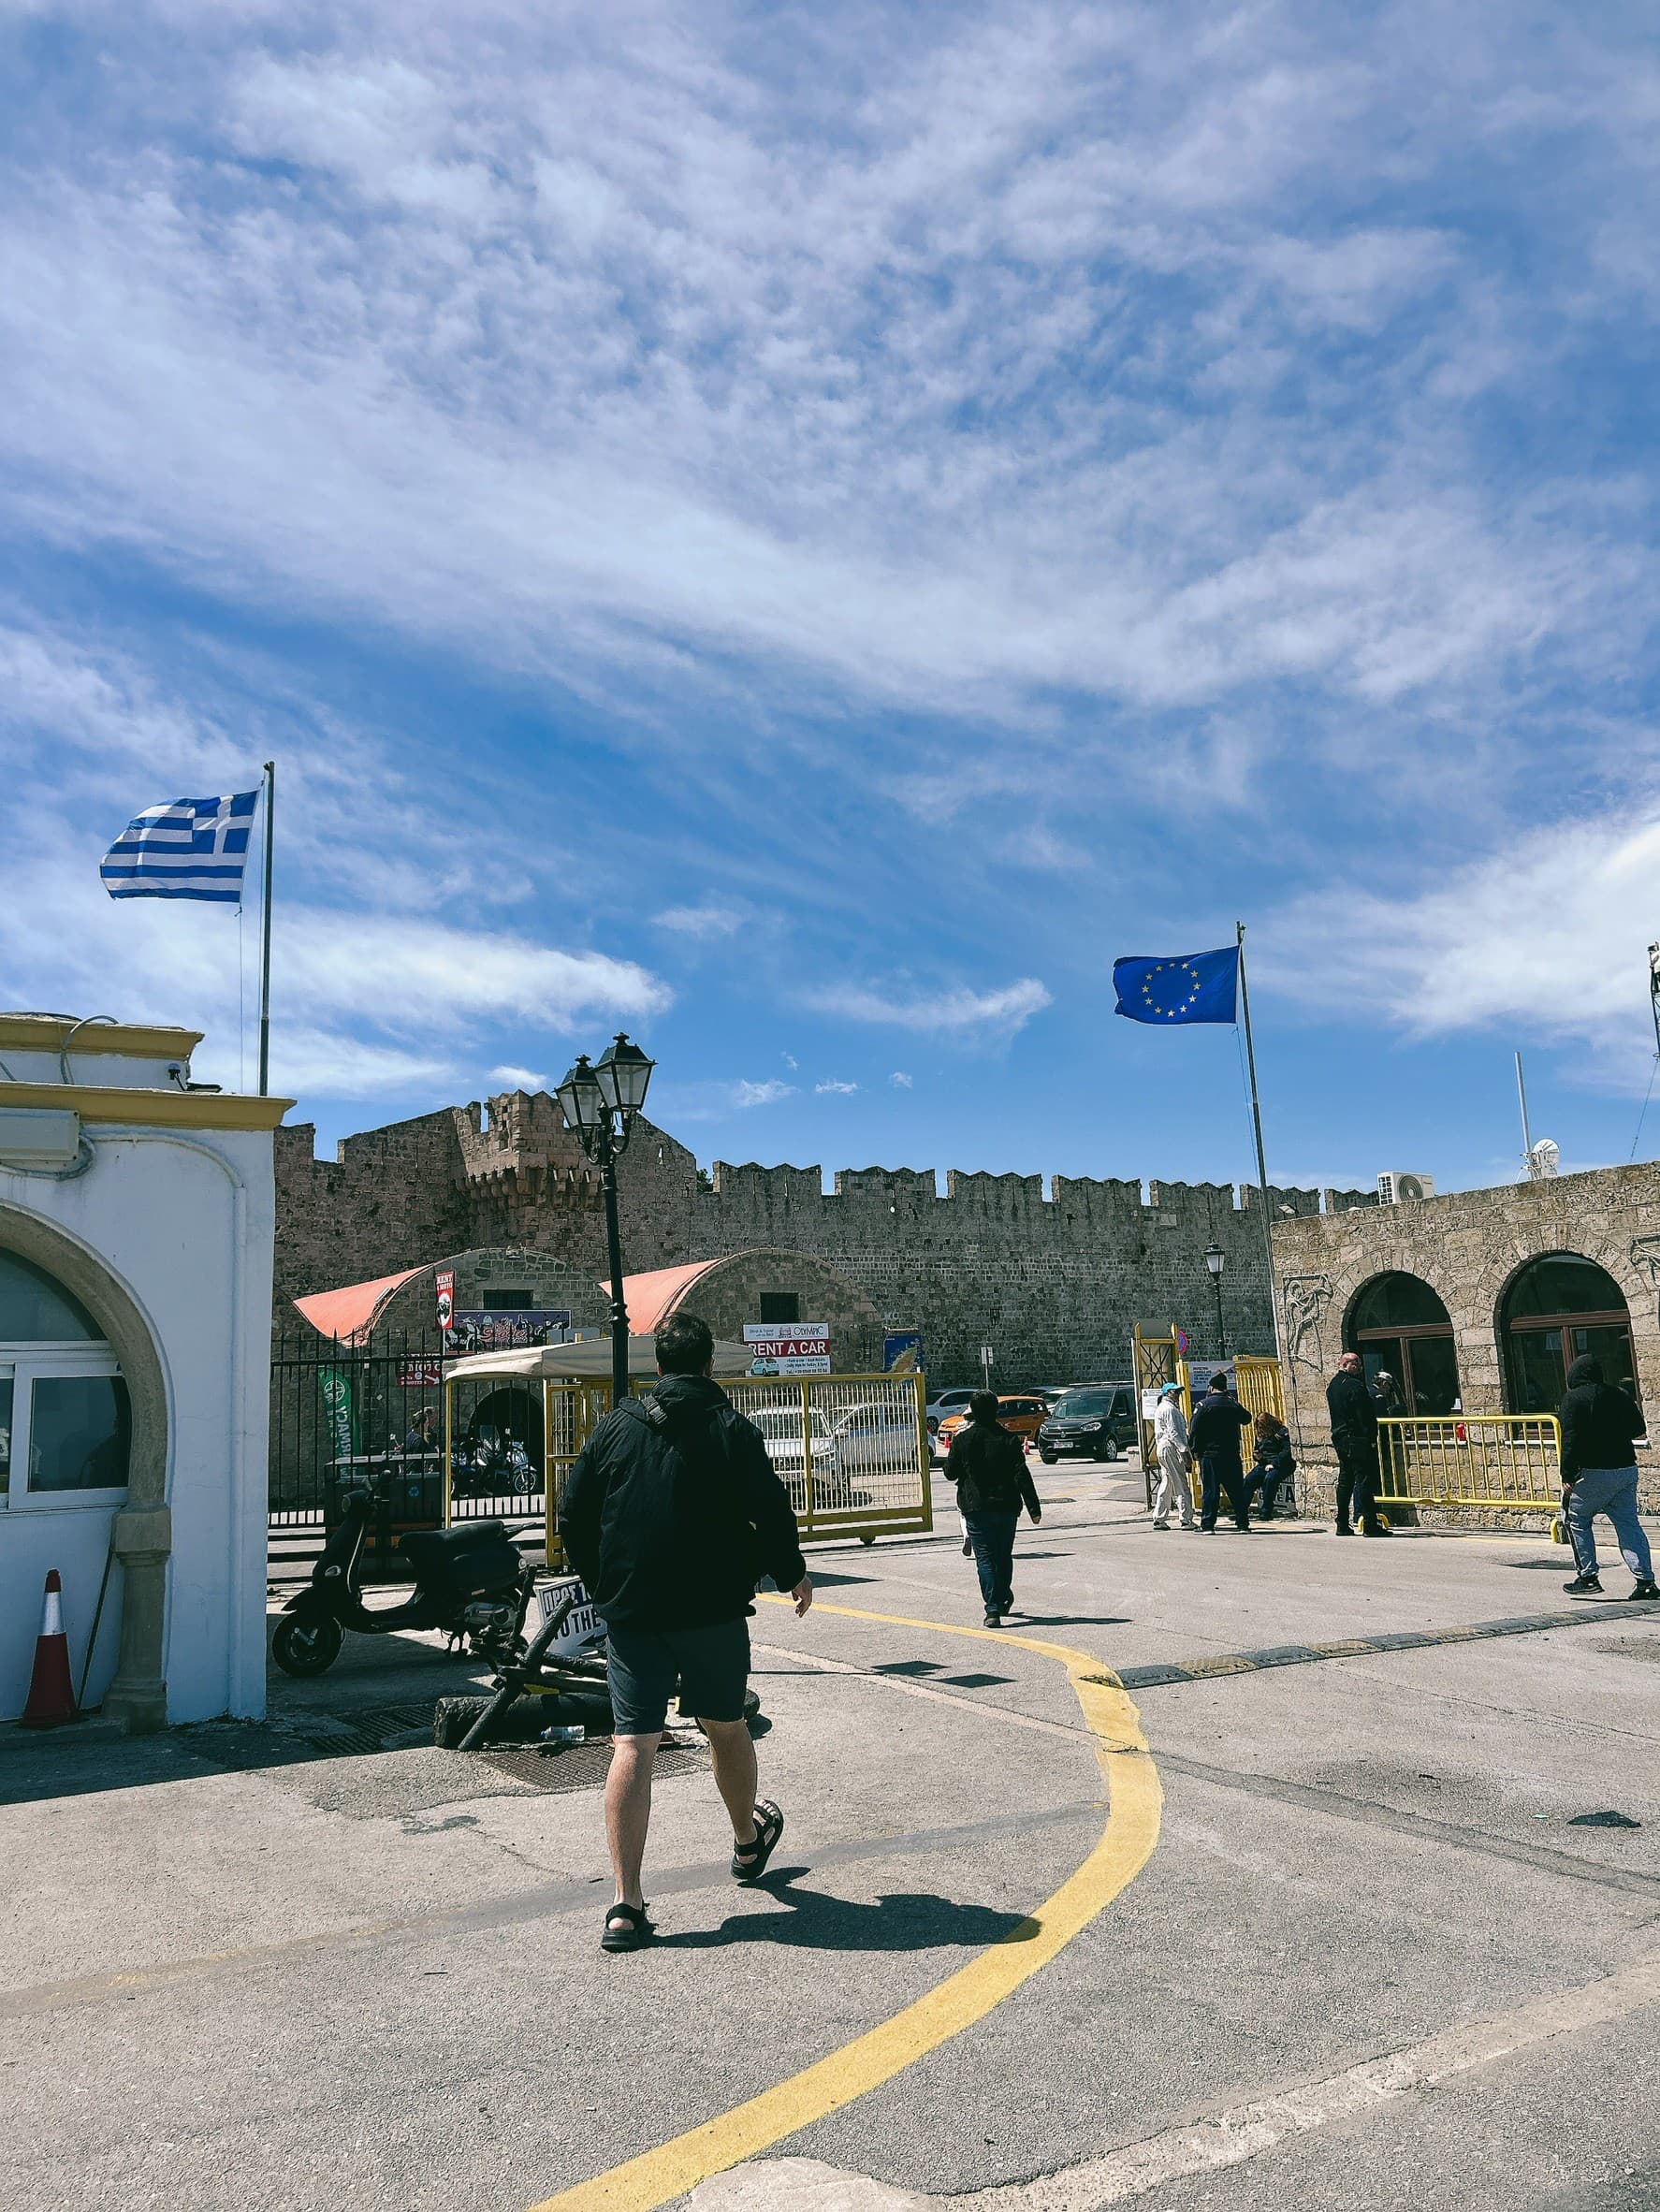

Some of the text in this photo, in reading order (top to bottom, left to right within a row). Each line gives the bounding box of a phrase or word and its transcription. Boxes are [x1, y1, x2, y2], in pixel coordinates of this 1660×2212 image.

[788, 1342, 797, 1354] A
[799, 1341, 825, 1354] CAR
[571, 1608, 602, 1634] THE
